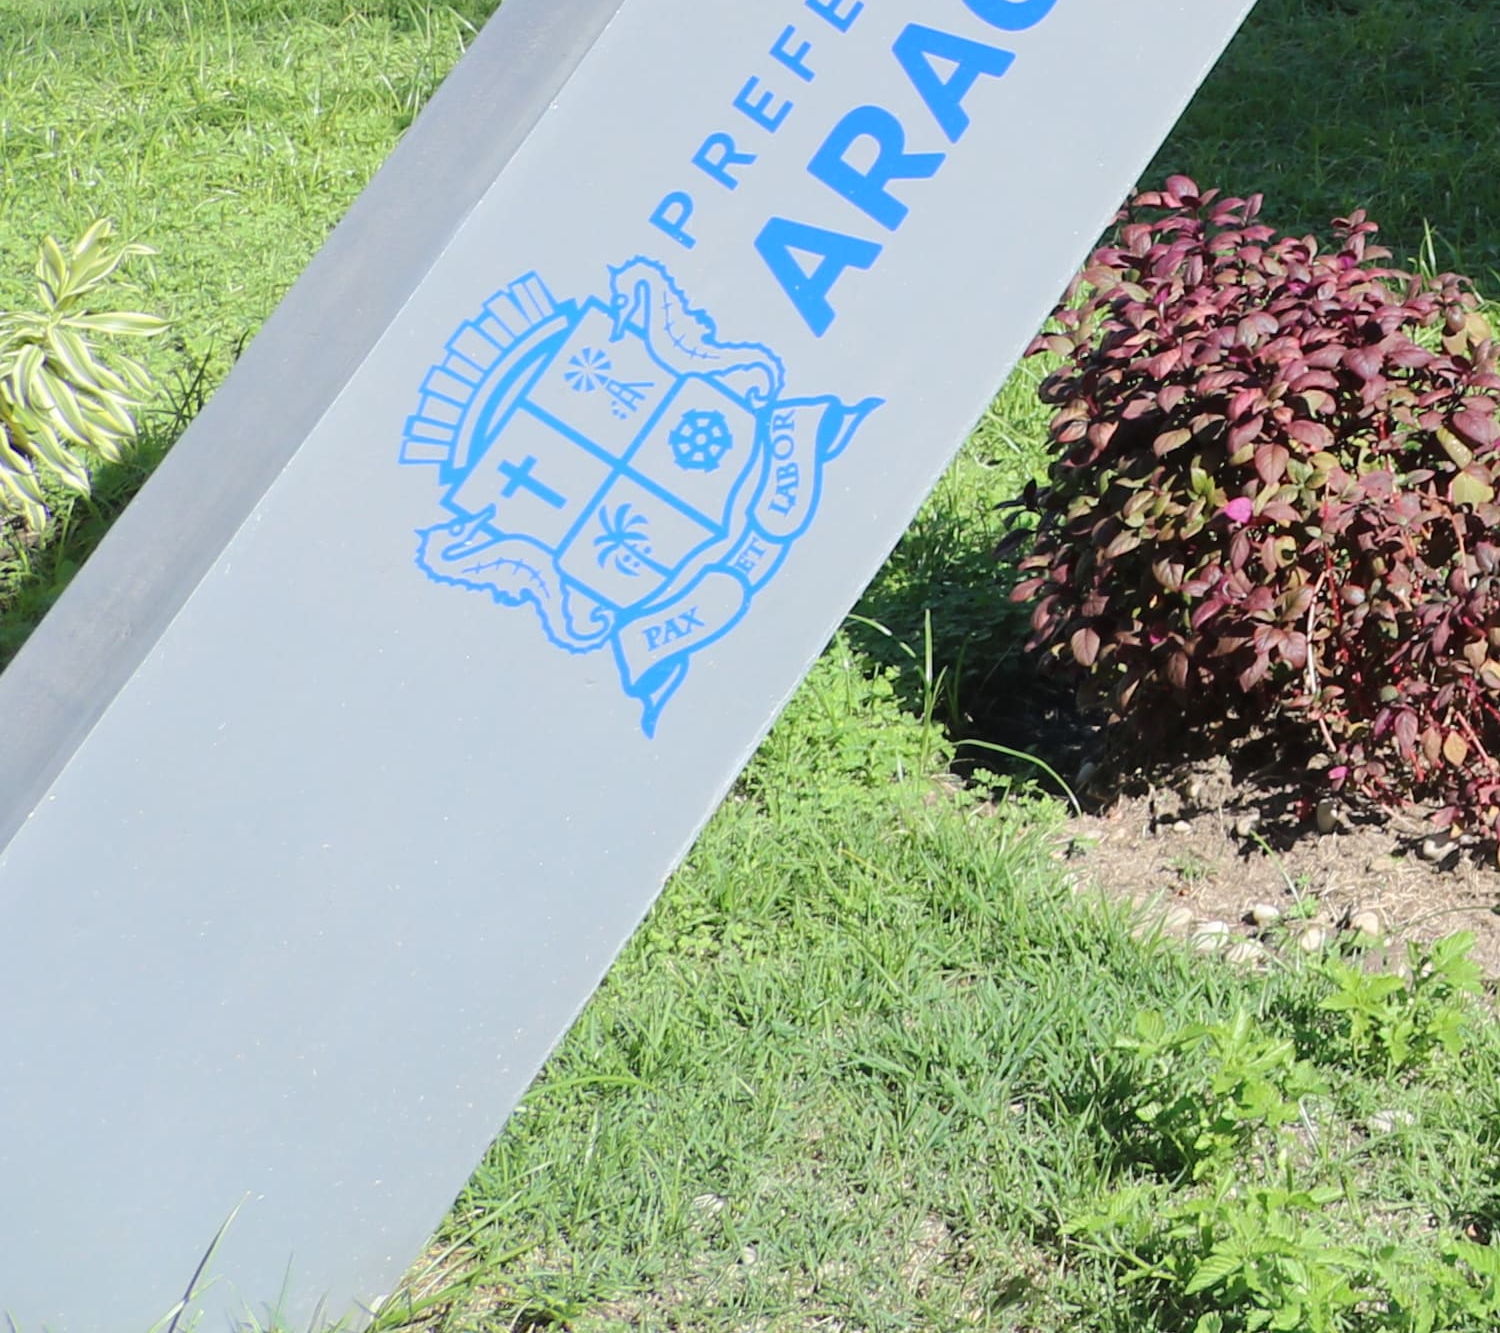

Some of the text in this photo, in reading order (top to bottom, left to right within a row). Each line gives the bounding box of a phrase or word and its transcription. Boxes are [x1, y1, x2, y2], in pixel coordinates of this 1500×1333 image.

[641, 409, 800, 652] PAX ET LABOR
